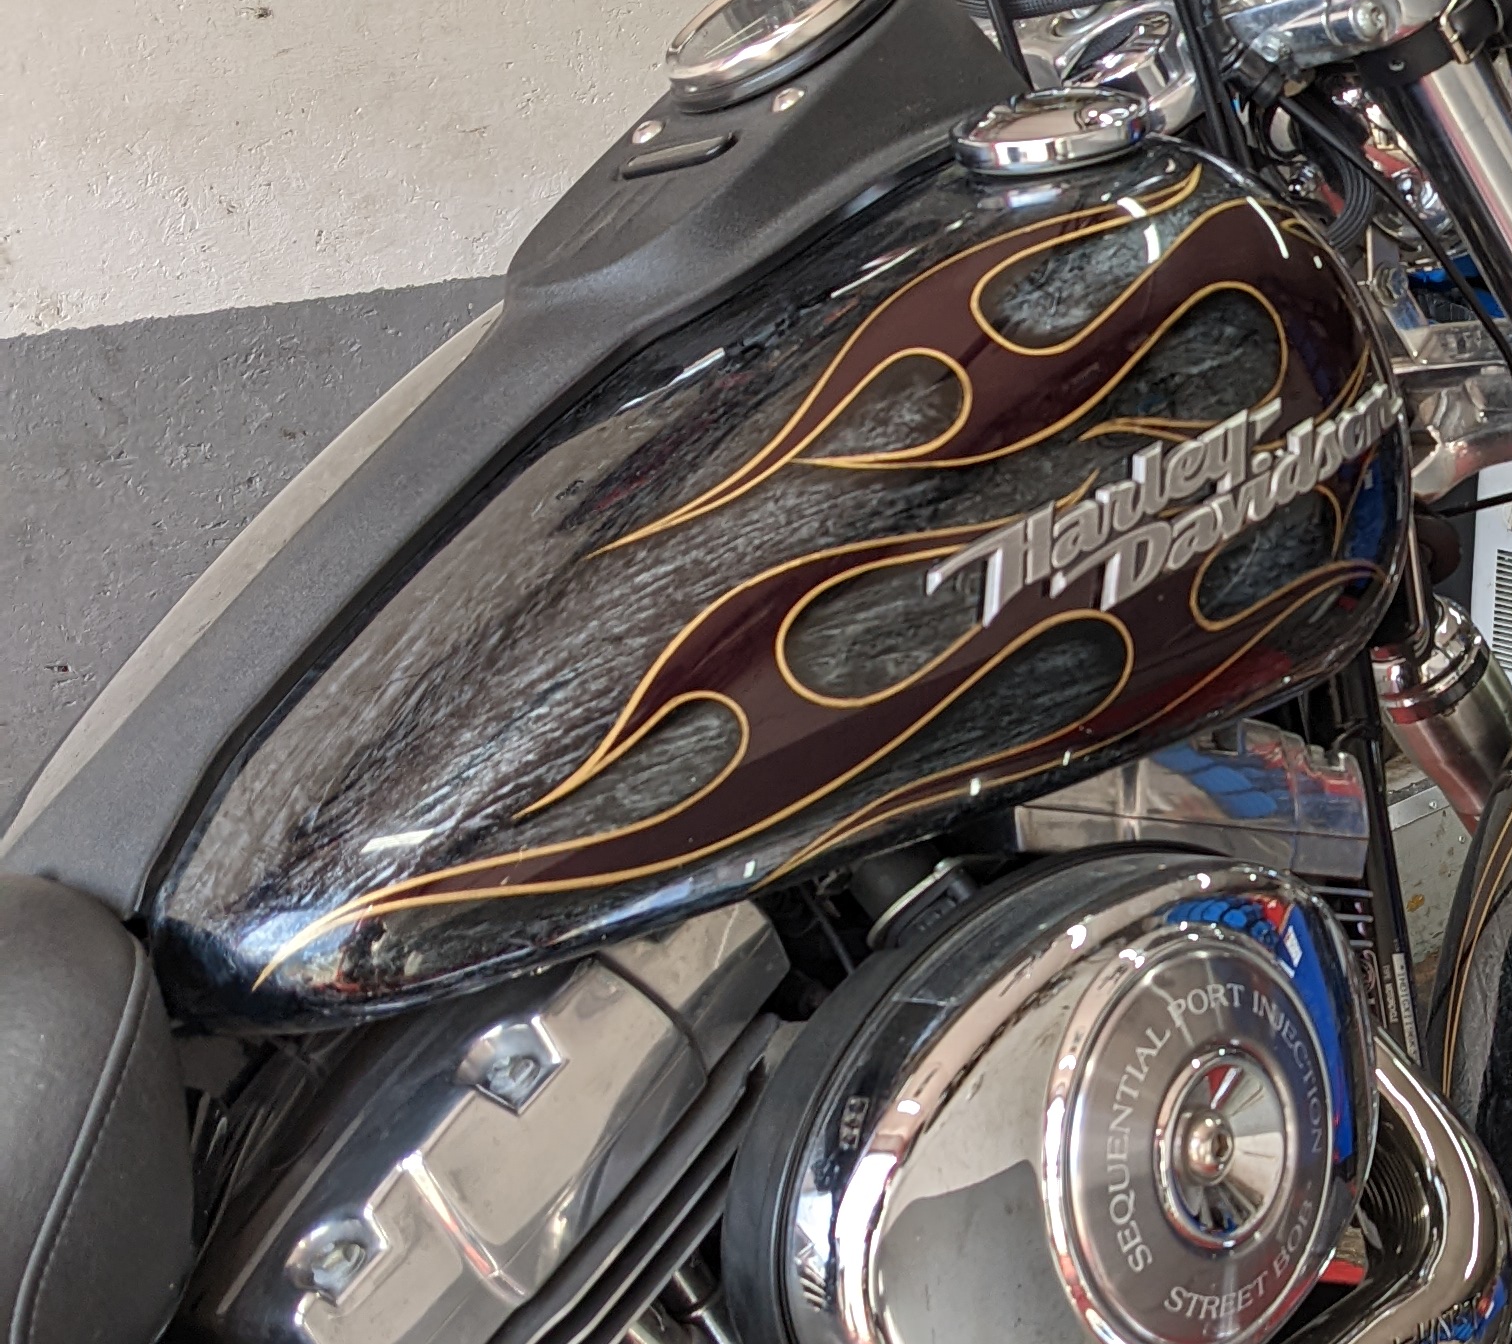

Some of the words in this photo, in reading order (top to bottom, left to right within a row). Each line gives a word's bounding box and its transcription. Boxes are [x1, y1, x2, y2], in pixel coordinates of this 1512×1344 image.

[1049, 383, 1403, 611] Davidson
[1106, 1026, 1171, 1273] SEQUENTIAL
[1168, 982, 1246, 1028] PORT
[1253, 989, 1323, 1154] INJECTION
[1164, 1270, 1269, 1321] STREET
[1270, 1199, 1314, 1278] BOB
